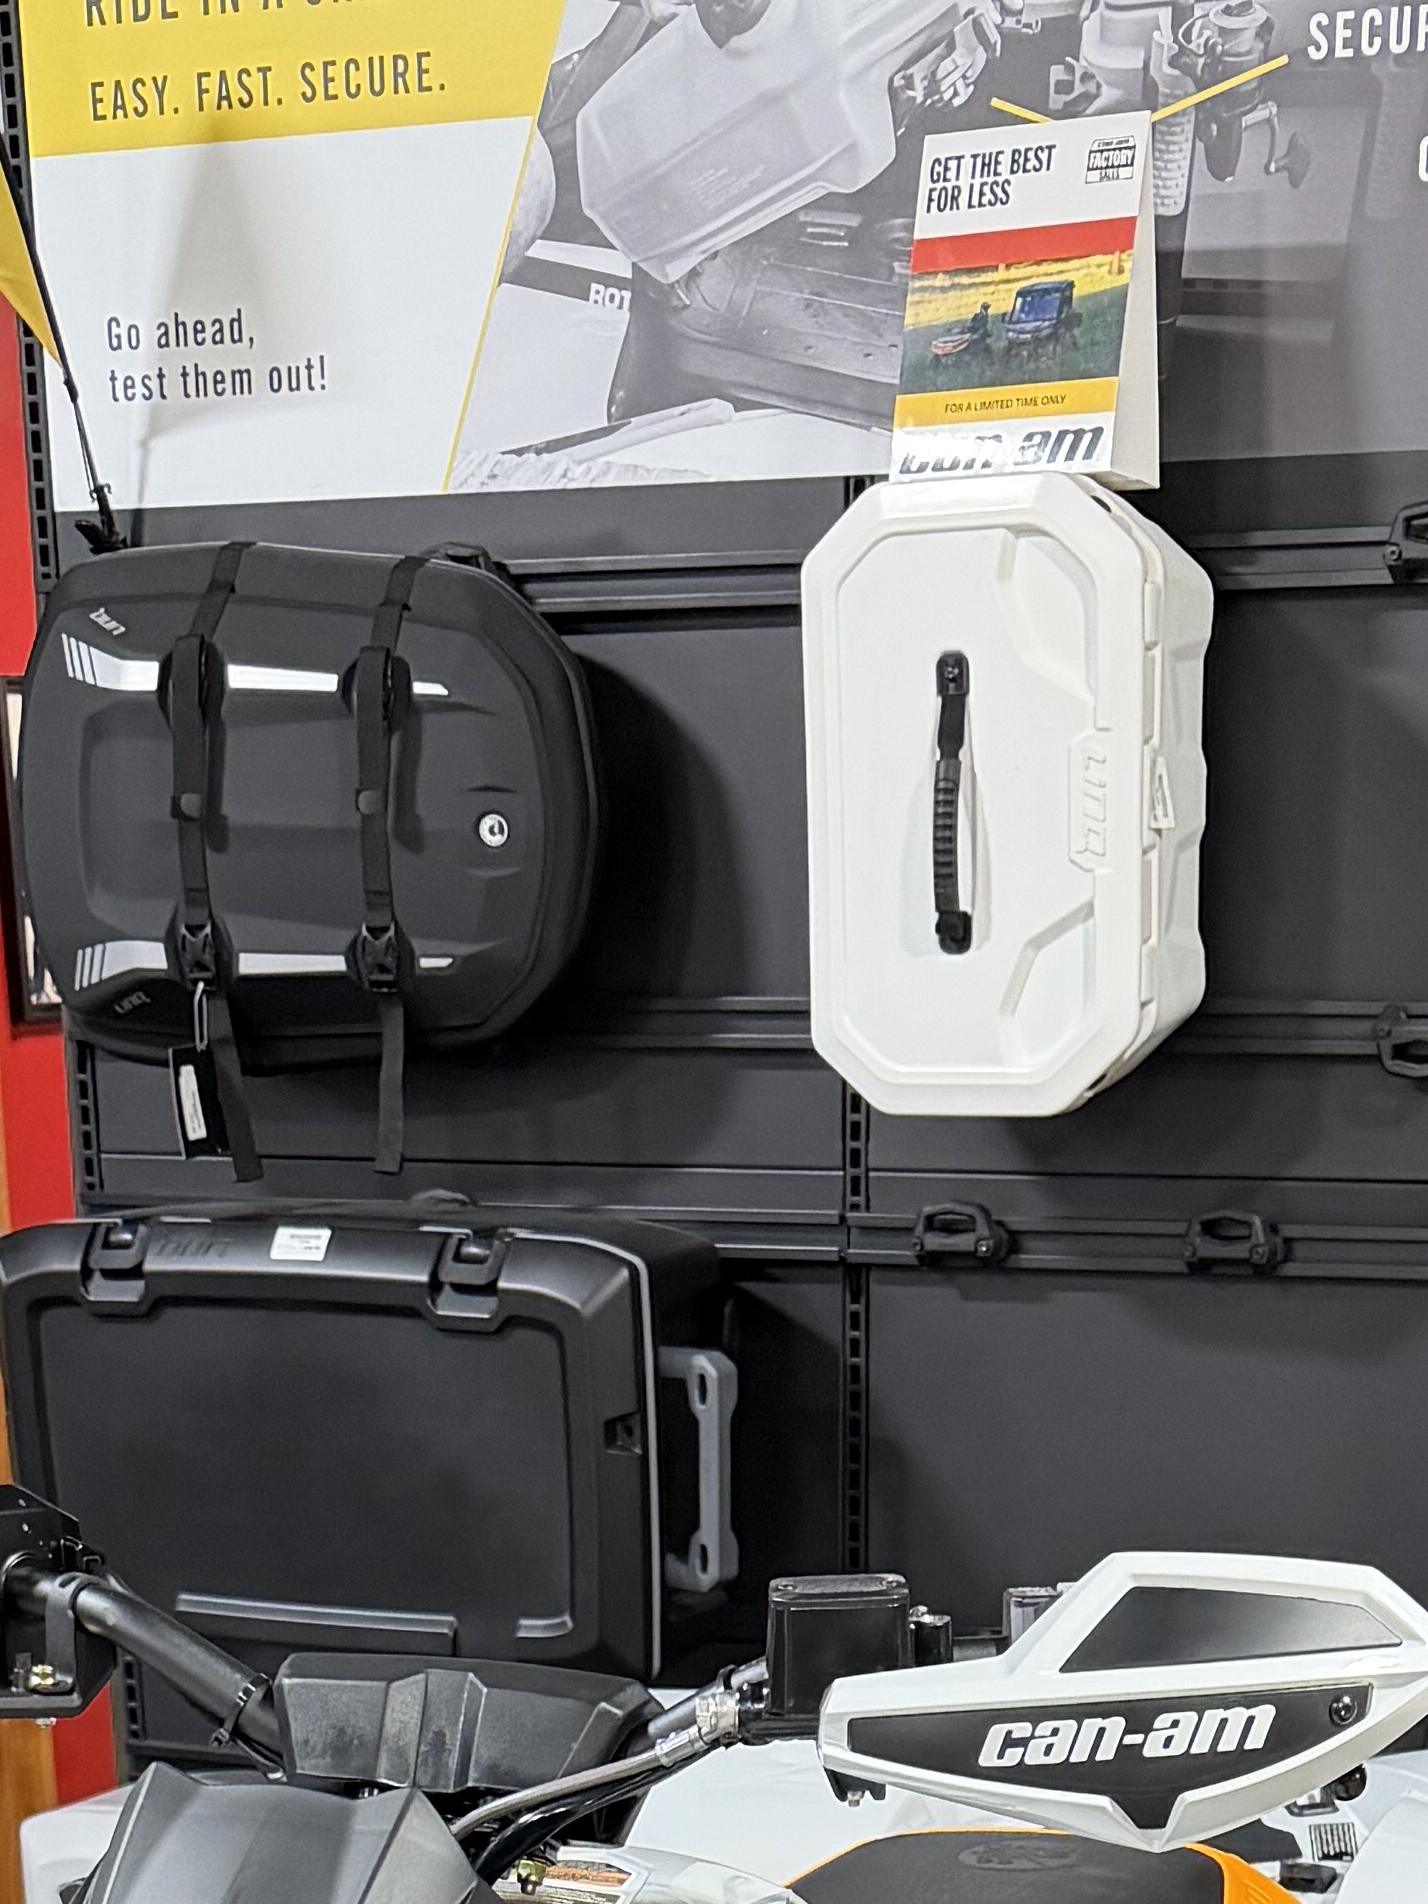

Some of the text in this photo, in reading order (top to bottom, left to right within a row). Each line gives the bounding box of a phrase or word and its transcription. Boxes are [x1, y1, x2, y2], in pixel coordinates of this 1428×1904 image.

[91, 51, 447, 122] EASY. FAST. SECURE.
[930, 144, 1057, 185] GET THE BEST
[1089, 147, 1136, 170] FACTORY
[926, 178, 1012, 214] FOR LESS
[106, 309, 256, 352] Go ahead,
[109, 355, 328, 404] test them out!
[944, 394, 1067, 414] FOR A LIMITED TIME ONLY
[978, 1703, 1276, 1769] can-am
